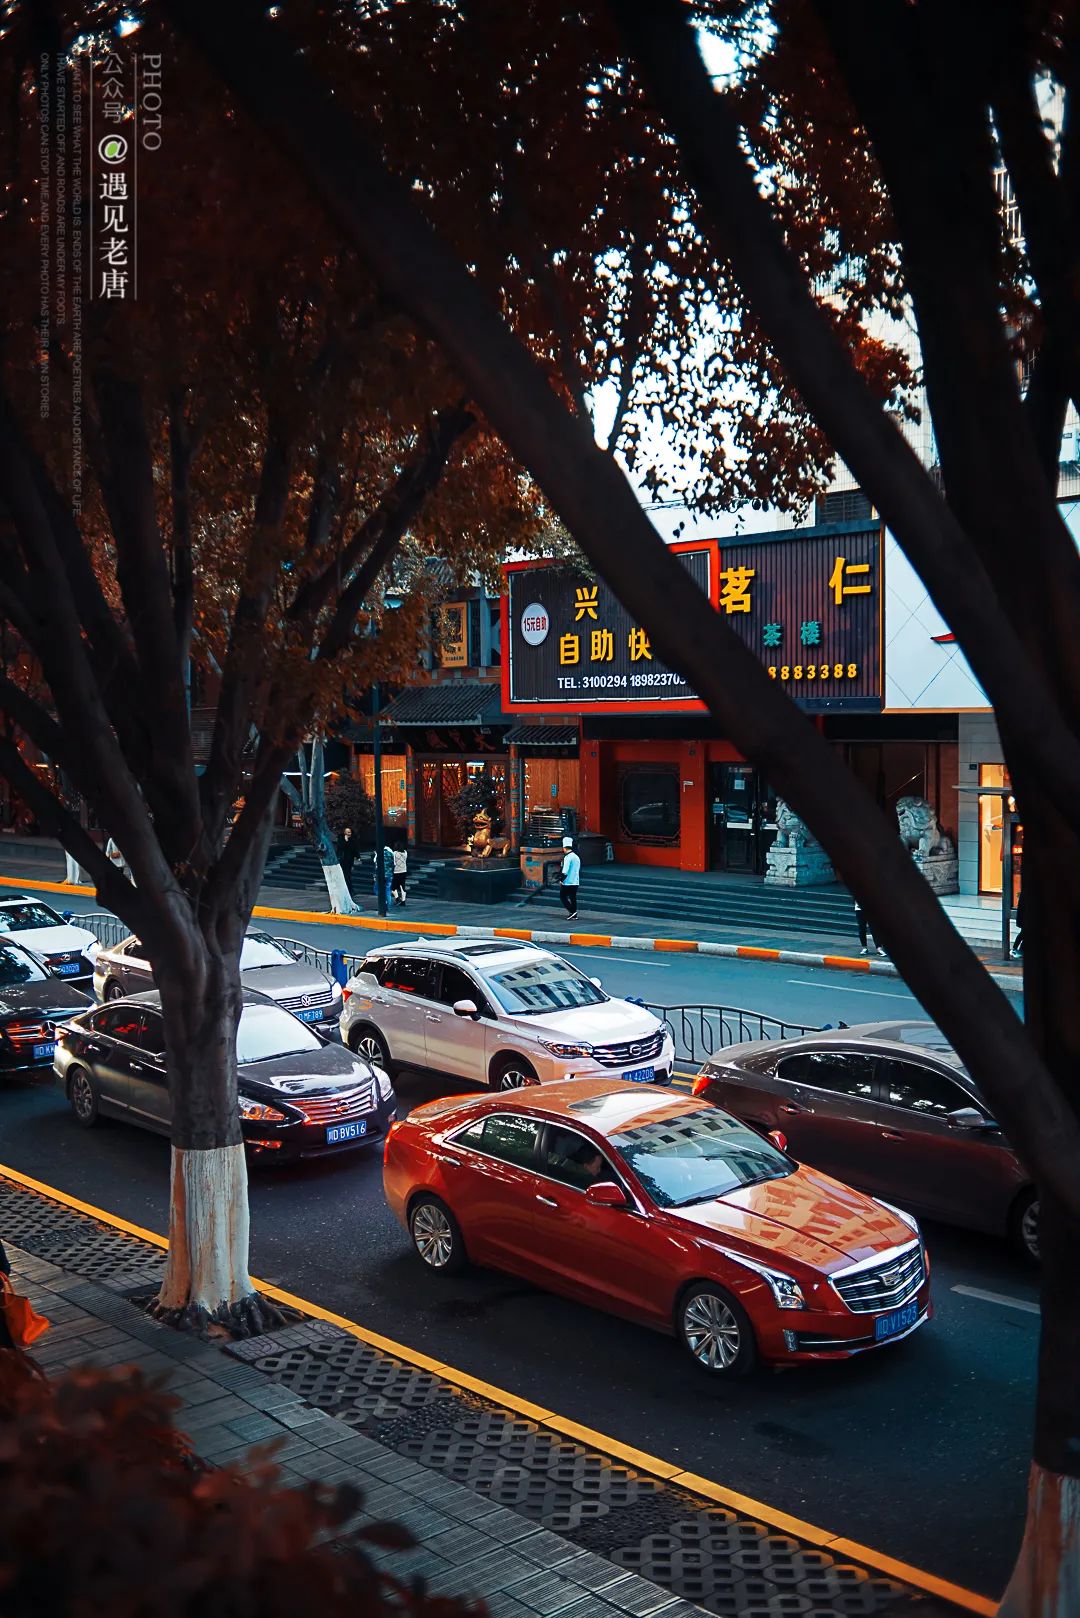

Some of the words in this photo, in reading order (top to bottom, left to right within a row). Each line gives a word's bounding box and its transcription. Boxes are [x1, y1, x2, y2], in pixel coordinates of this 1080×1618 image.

[574, 585, 599, 621] 兴
[762, 620, 822, 647] 茶楼
[629, 672, 687, 688] 18982370
